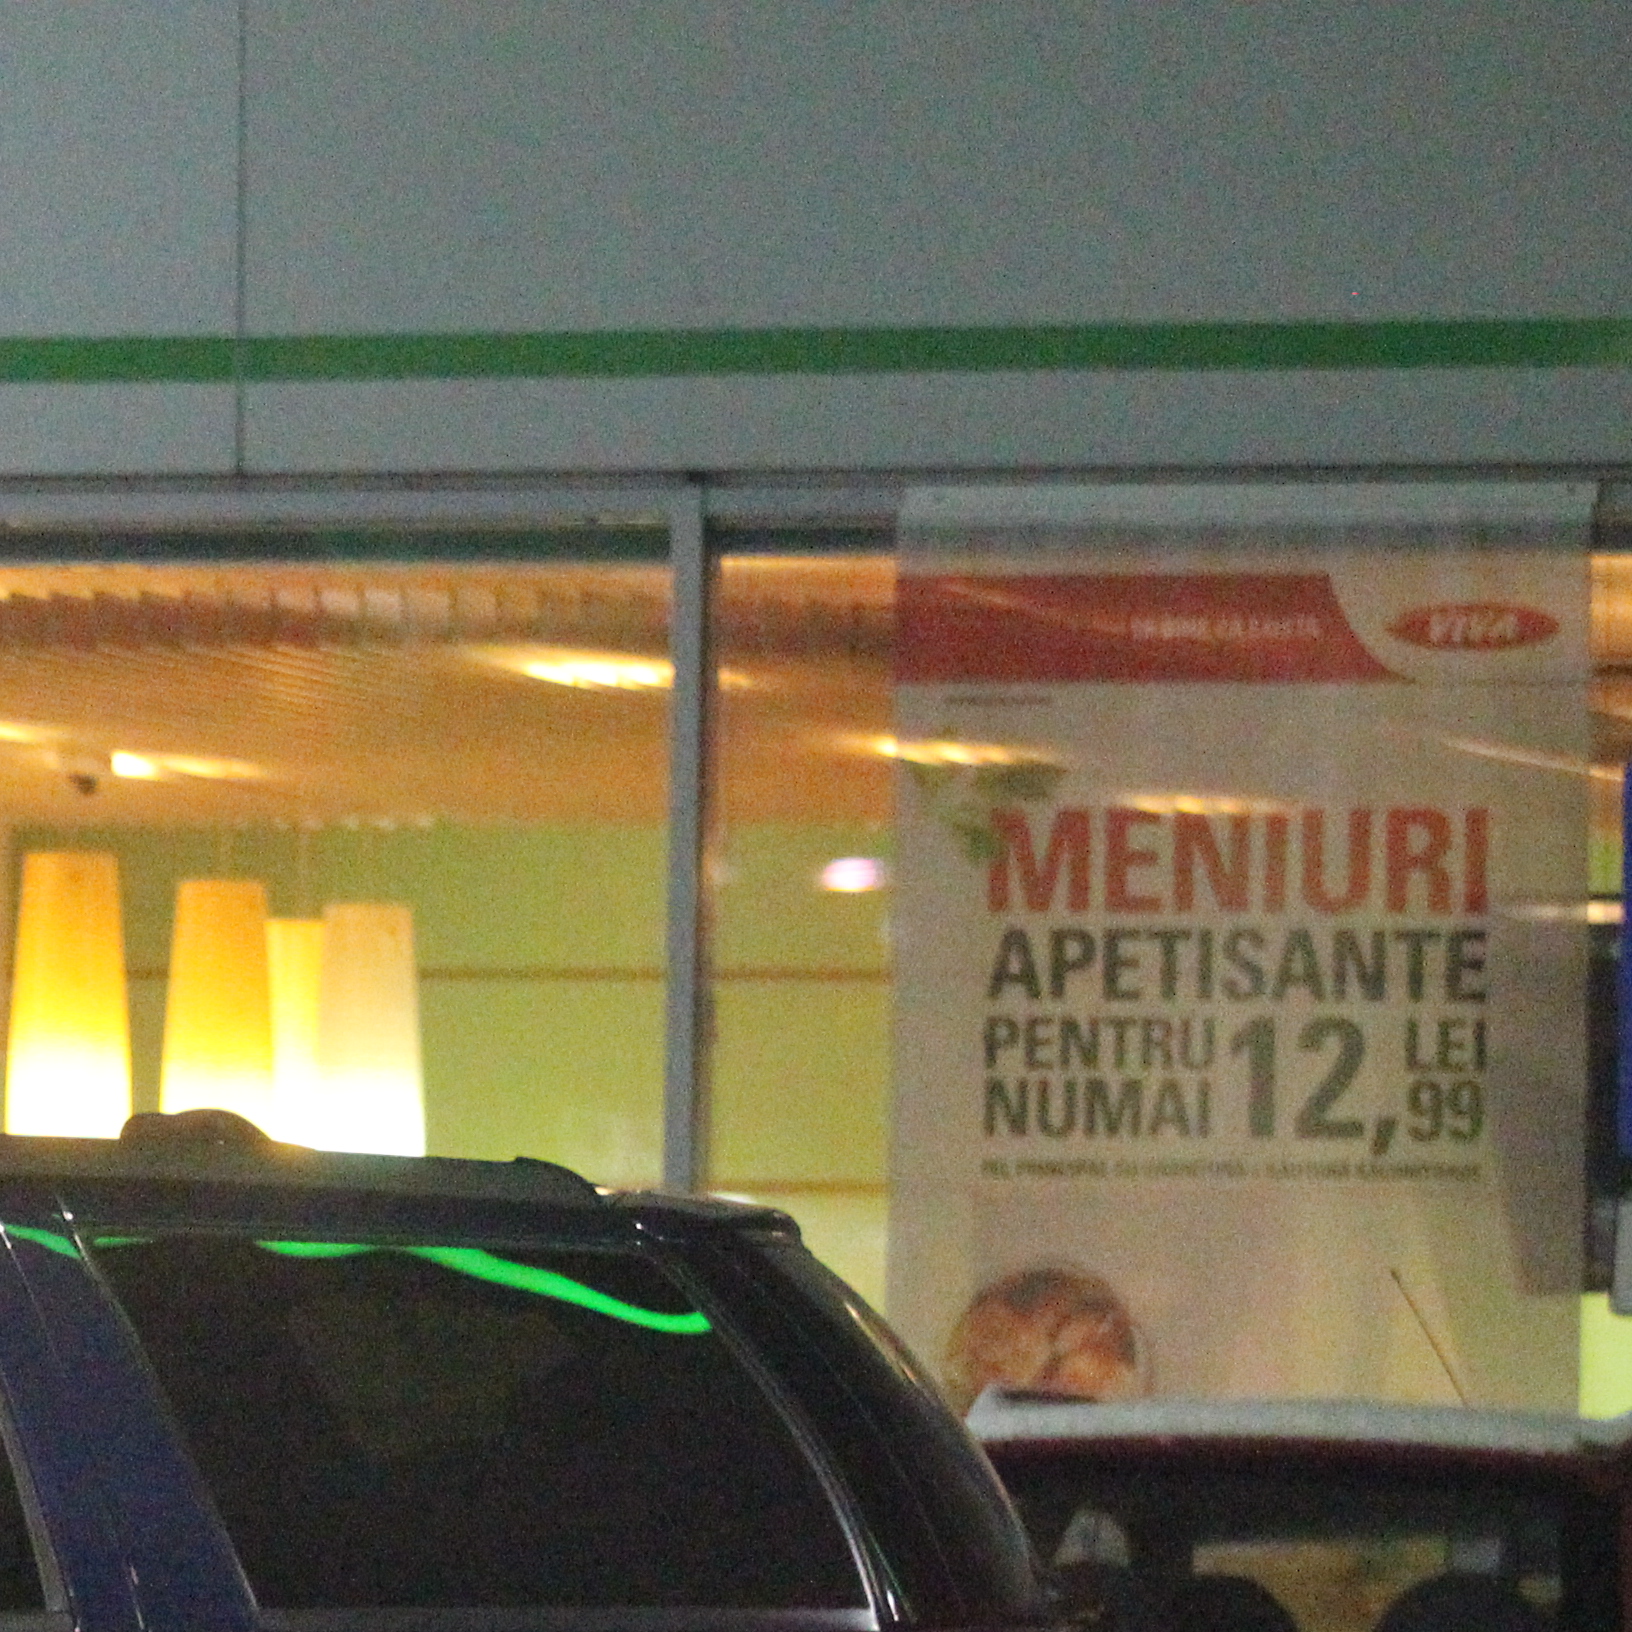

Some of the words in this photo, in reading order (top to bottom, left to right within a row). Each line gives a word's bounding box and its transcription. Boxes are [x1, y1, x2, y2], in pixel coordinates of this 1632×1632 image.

[989, 806, 1490, 914] MENIURI
[988, 929, 1487, 1004] APETISANTE
[984, 1015, 1215, 1074] PENTRU
[1405, 1016, 1487, 1073] LEI
[984, 1078, 1211, 1142] NUMAI
[1409, 1081, 1484, 1144] 99
